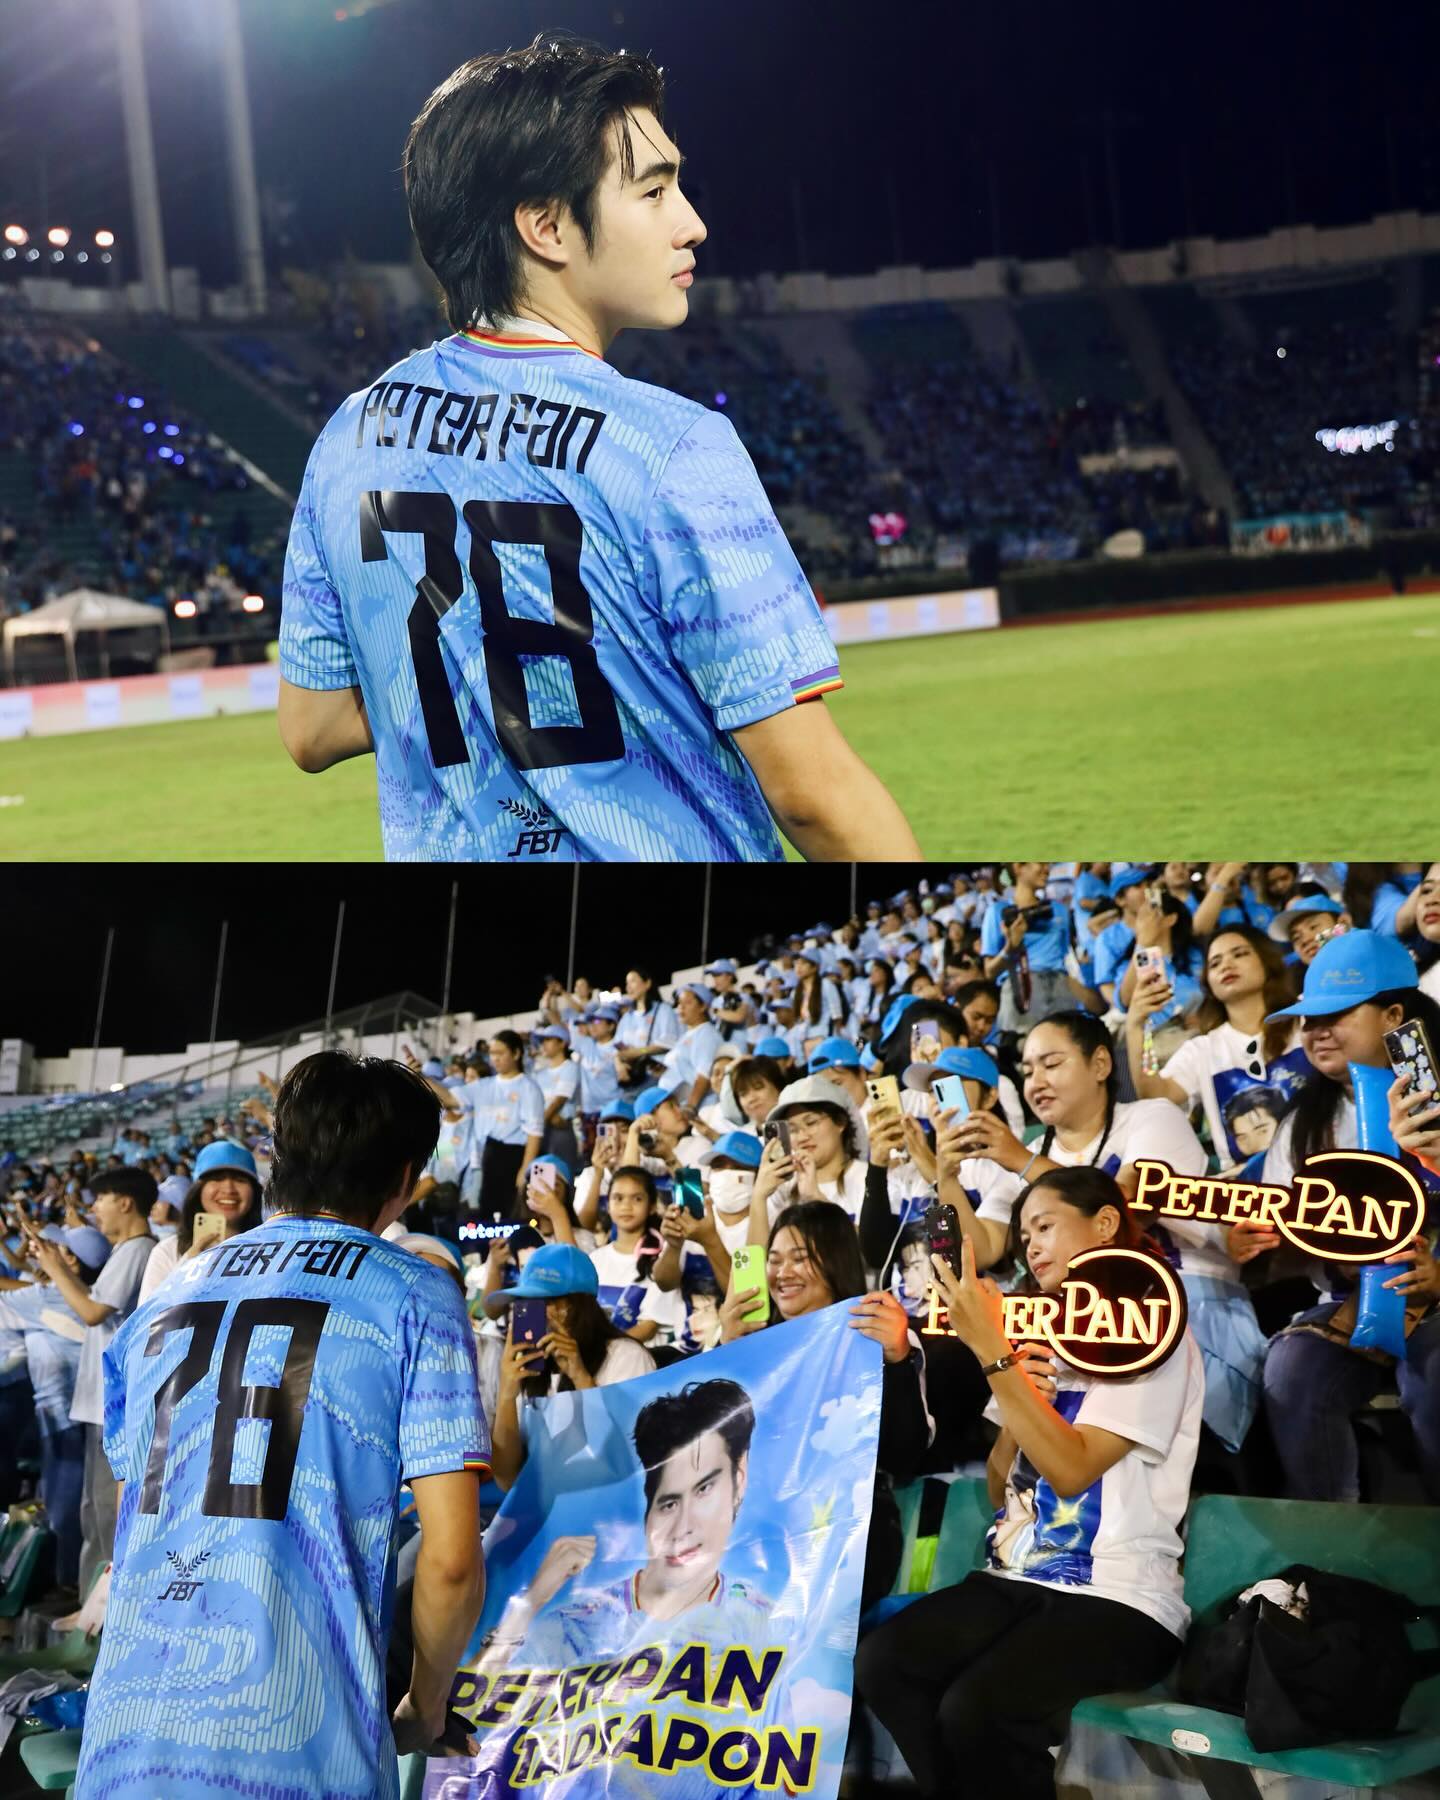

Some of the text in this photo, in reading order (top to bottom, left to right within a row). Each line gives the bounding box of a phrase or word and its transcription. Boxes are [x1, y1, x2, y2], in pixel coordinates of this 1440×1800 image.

[359, 489, 626, 771] 78
[507, 828, 568, 857] FBT
[136, 1297, 331, 1521] 78
[157, 1581, 204, 1601] FBT
[449, 1644, 785, 1724] PETERPAN
